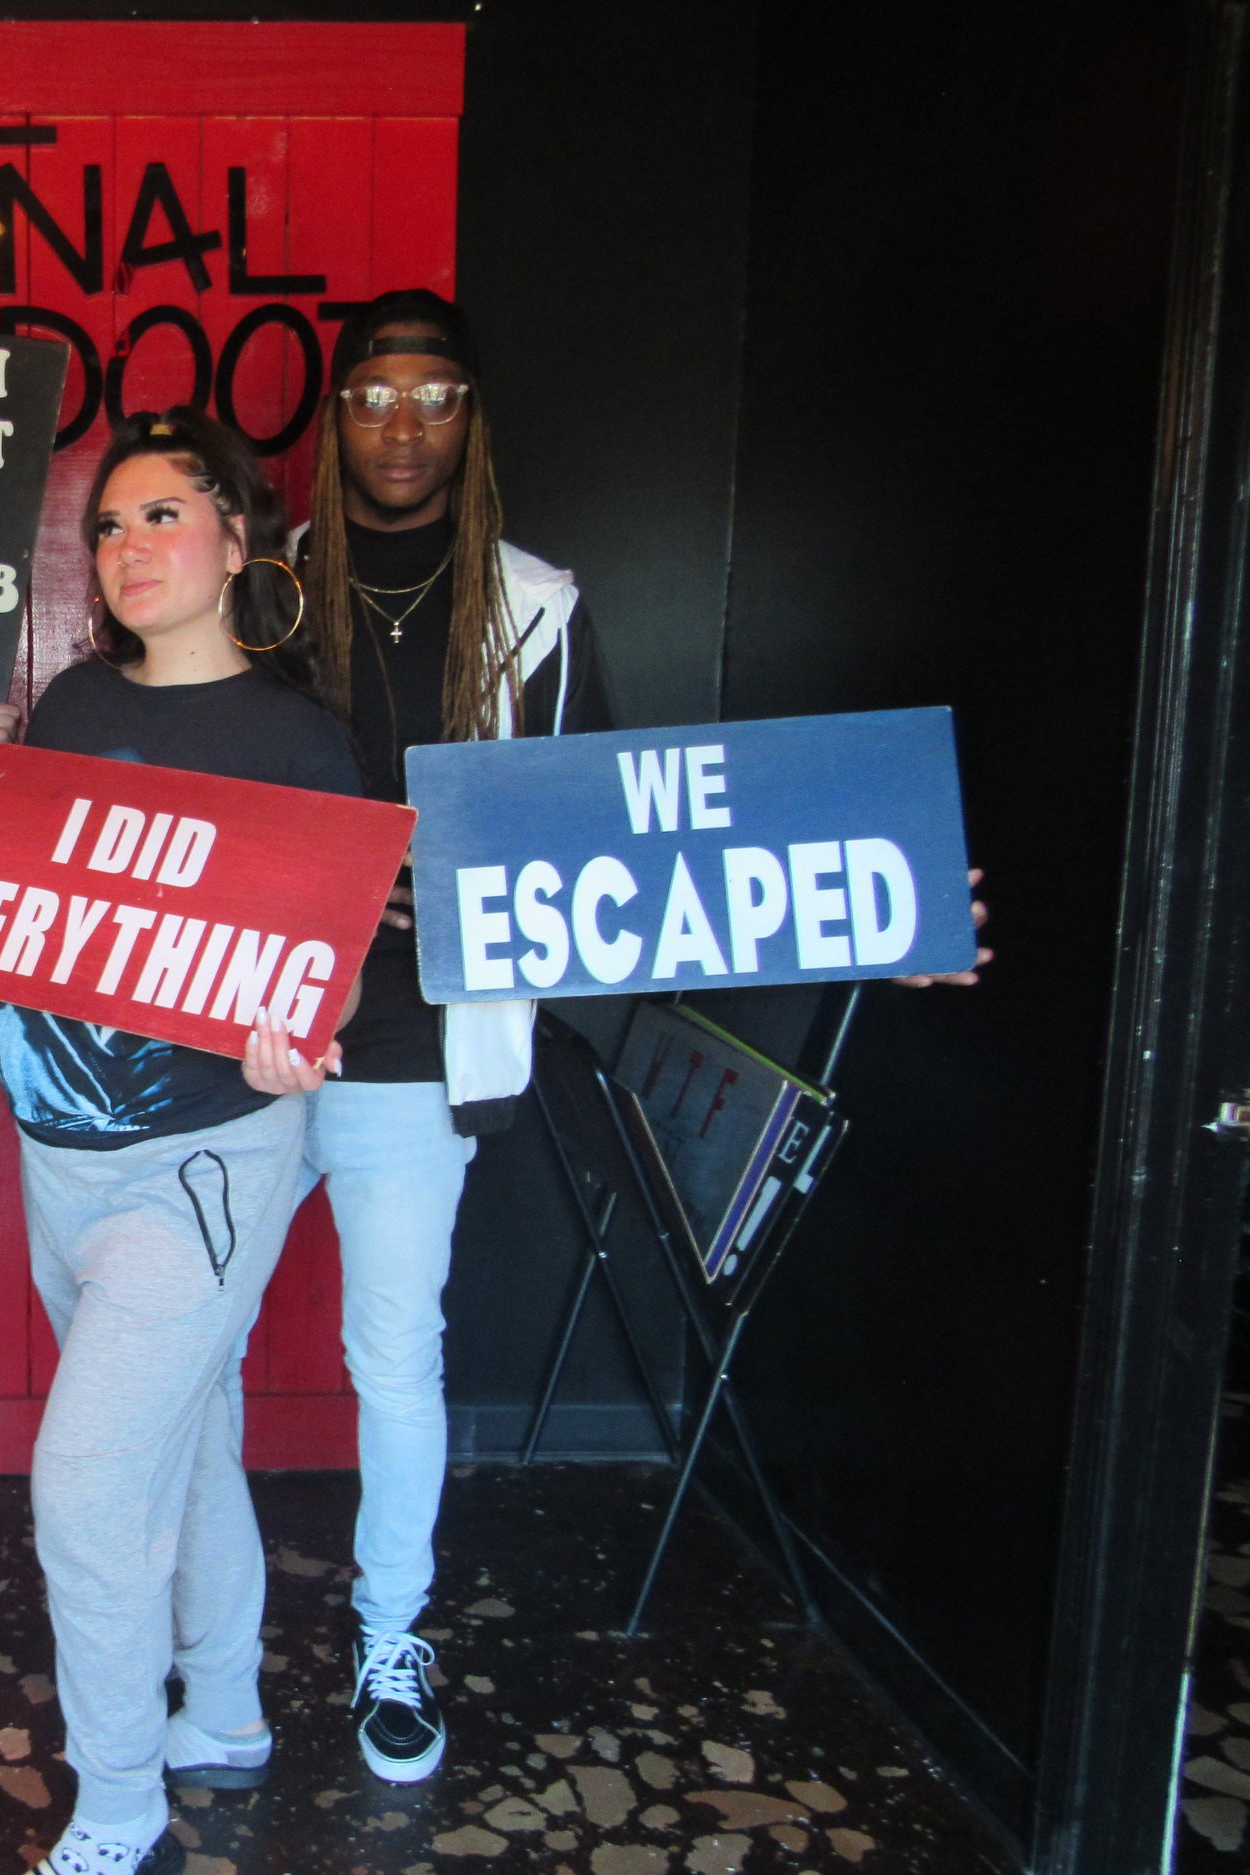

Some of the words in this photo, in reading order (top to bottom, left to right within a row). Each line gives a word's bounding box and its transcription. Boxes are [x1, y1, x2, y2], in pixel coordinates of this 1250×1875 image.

[617, 743, 732, 835] WE
[50, 797, 93, 865] I
[86, 804, 217, 889] DID
[455, 837, 918, 992] ESCAPED
